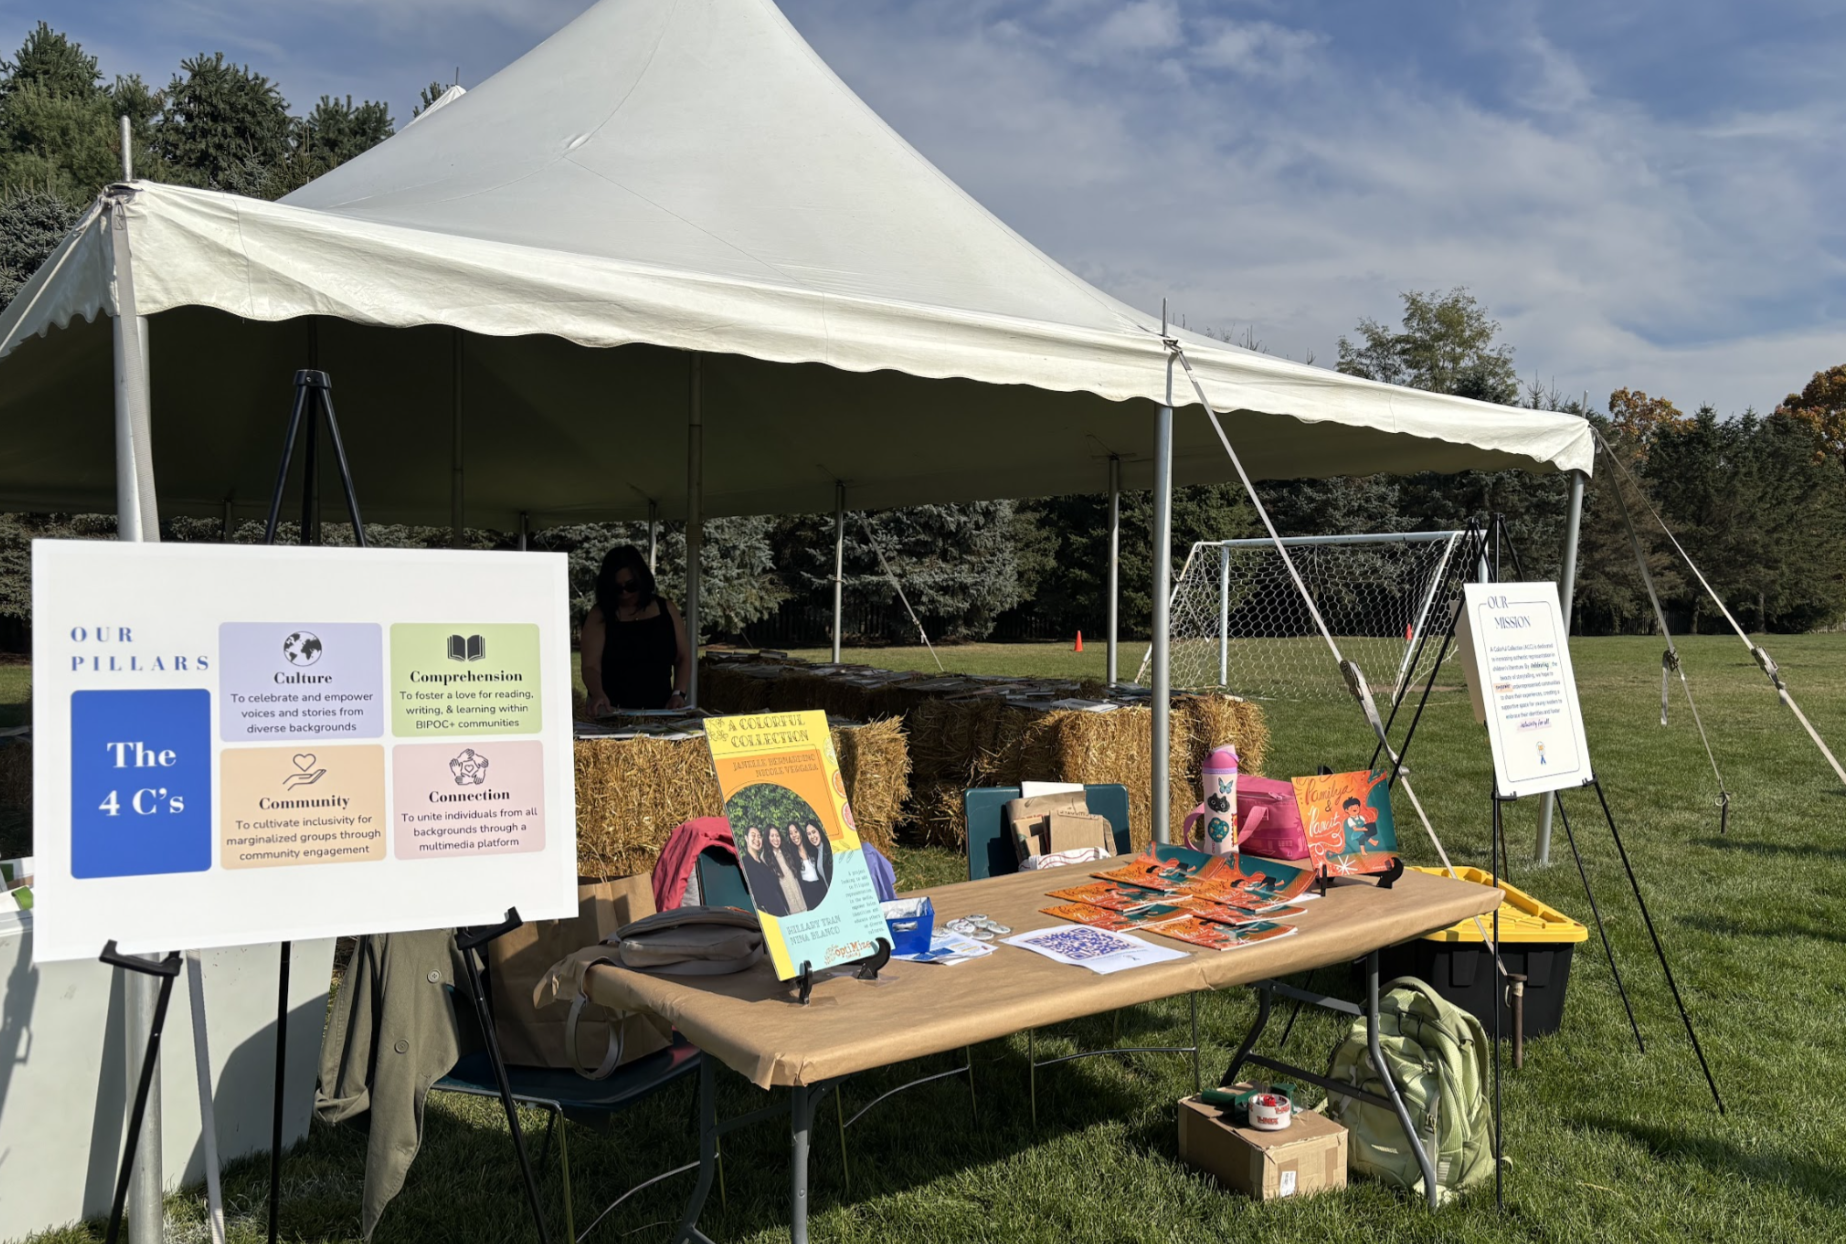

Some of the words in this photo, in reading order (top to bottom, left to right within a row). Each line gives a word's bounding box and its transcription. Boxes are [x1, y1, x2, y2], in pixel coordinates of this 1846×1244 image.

[1488, 596, 1508, 609] OUR
[1494, 616, 1531, 629] MISSION
[70, 626, 133, 642] OUR
[71, 655, 209, 671] PILLARS
[274, 672, 332, 684] Culture
[410, 670, 522, 686] Comprehension
[231, 694, 245, 703] To
[248, 693, 298, 703] celebrate
[302, 693, 321, 702] and
[324, 693, 373, 703] empower
[399, 691, 412, 700] To
[415, 691, 444, 699] foster
[456, 690, 476, 699] love
[479, 690, 492, 698] for
[495, 690, 534, 699] reading,
[241, 710, 275, 718] voices
[279, 709, 298, 717] and
[302, 707, 336, 717] stories
[339, 707, 363, 716] from
[406, 706, 443, 716] writing,
[446, 705, 453, 713] &
[456, 705, 496, 714] learning
[499, 704, 528, 713] within
[247, 725, 286, 733] diverse
[289, 723, 356, 733] backgrounds
[416, 720, 455, 729] BIPOC+
[458, 719, 519, 728] communities
[729, 720, 737, 731] A
[739, 714, 805, 730] COLORFUL
[731, 730, 809, 748] COLLECTION
[107, 741, 176, 768] The
[429, 789, 510, 803] Connection
[1305, 778, 1353, 805] Pamilya
[99, 790, 120, 816] 4
[132, 788, 184, 815] C's
[259, 795, 350, 810] Community
[1325, 800, 1331, 812] &
[402, 813, 414, 822] To
[418, 812, 442, 821] unite
[445, 809, 497, 820] individuals
[500, 808, 522, 817] from
[526, 807, 538, 816] all
[1308, 805, 1340, 837] Pancit
[236, 820, 250, 829] To
[253, 819, 299, 829] cultivate
[303, 816, 355, 826] inclusivity
[358, 815, 372, 823] for
[414, 825, 477, 837] backgrounds
[480, 823, 518, 833] through
[227, 833, 297, 846] marginalized
[300, 832, 337, 843] groups
[340, 829, 381, 840] through
[420, 840, 474, 851] multimedia
[478, 838, 519, 849] platform
[240, 848, 300, 860] community
[303, 845, 369, 858] engagement
